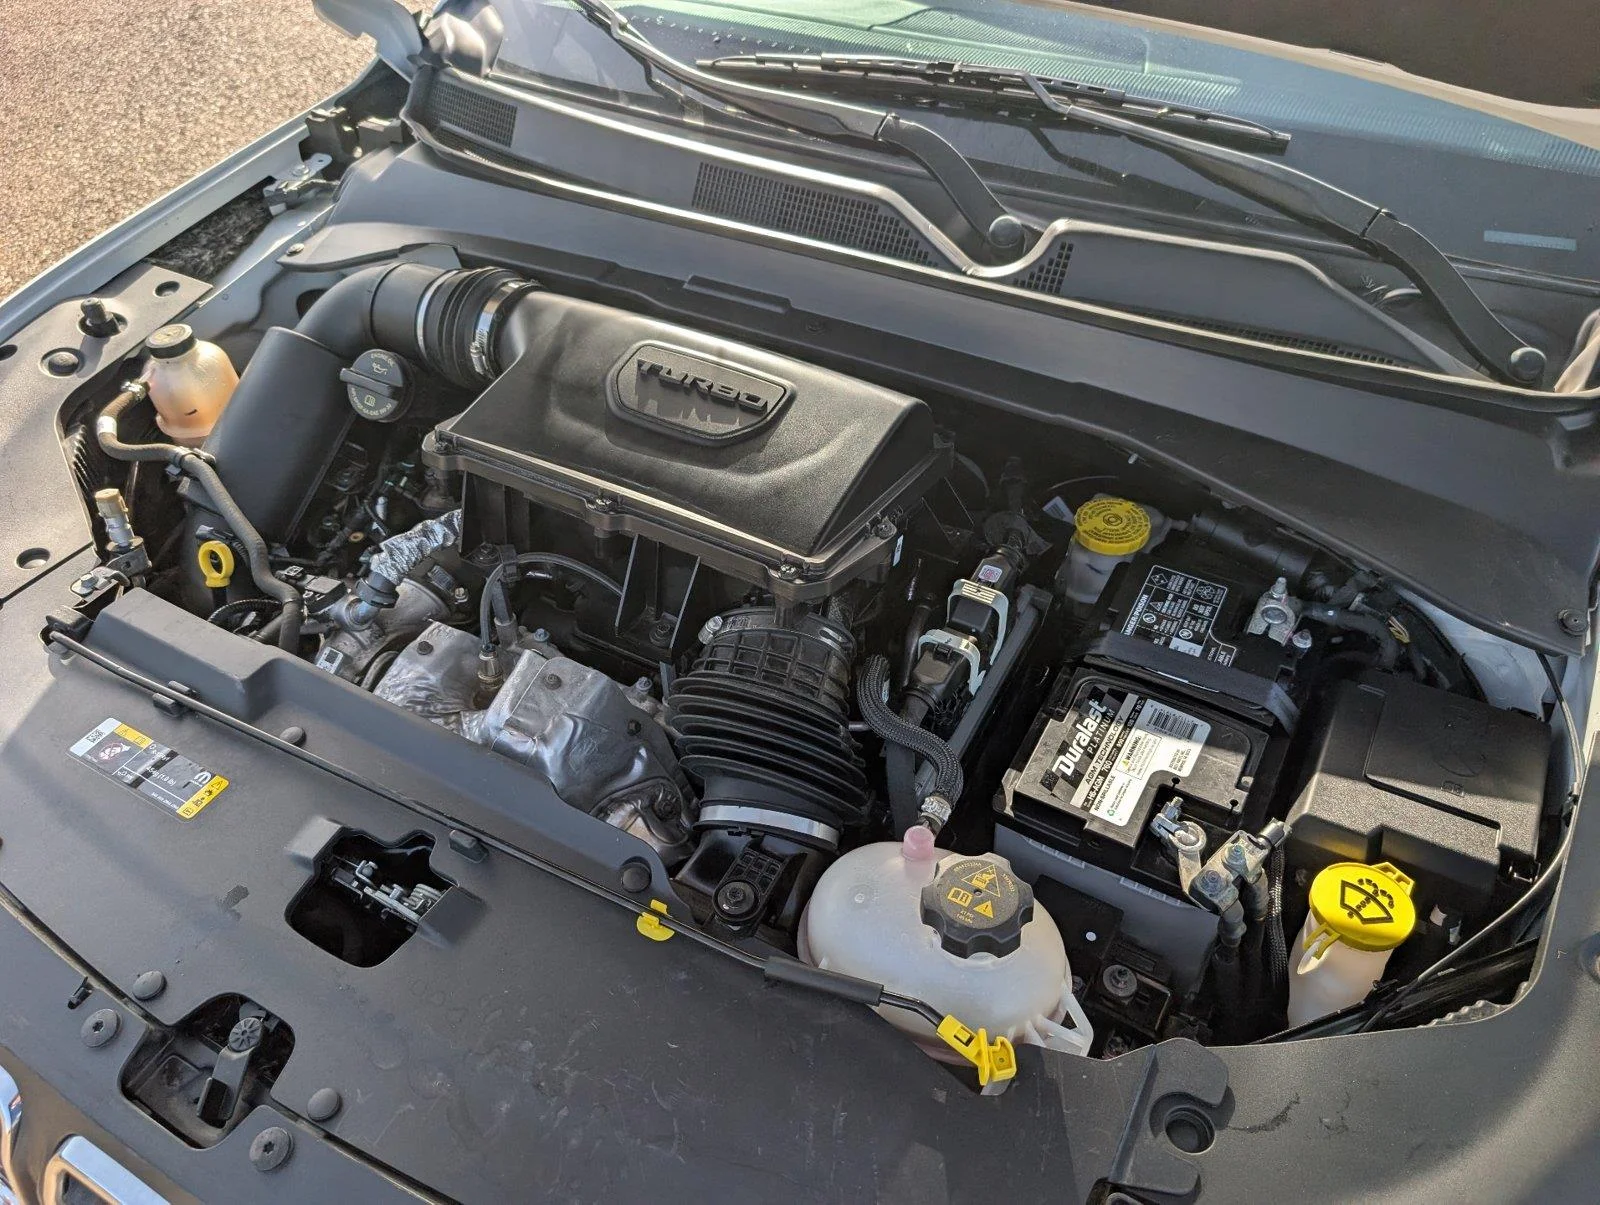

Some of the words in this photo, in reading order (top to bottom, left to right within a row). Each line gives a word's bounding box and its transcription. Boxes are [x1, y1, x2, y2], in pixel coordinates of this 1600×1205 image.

[637, 358, 767, 412] TURBO
[1052, 698, 1107, 775] Duralast
[1084, 765, 1097, 784] AGM
[1094, 715, 1123, 763] TECHNOLOGY
[1086, 708, 1115, 754] PLATINUM
[1101, 759, 1112, 771] 760
